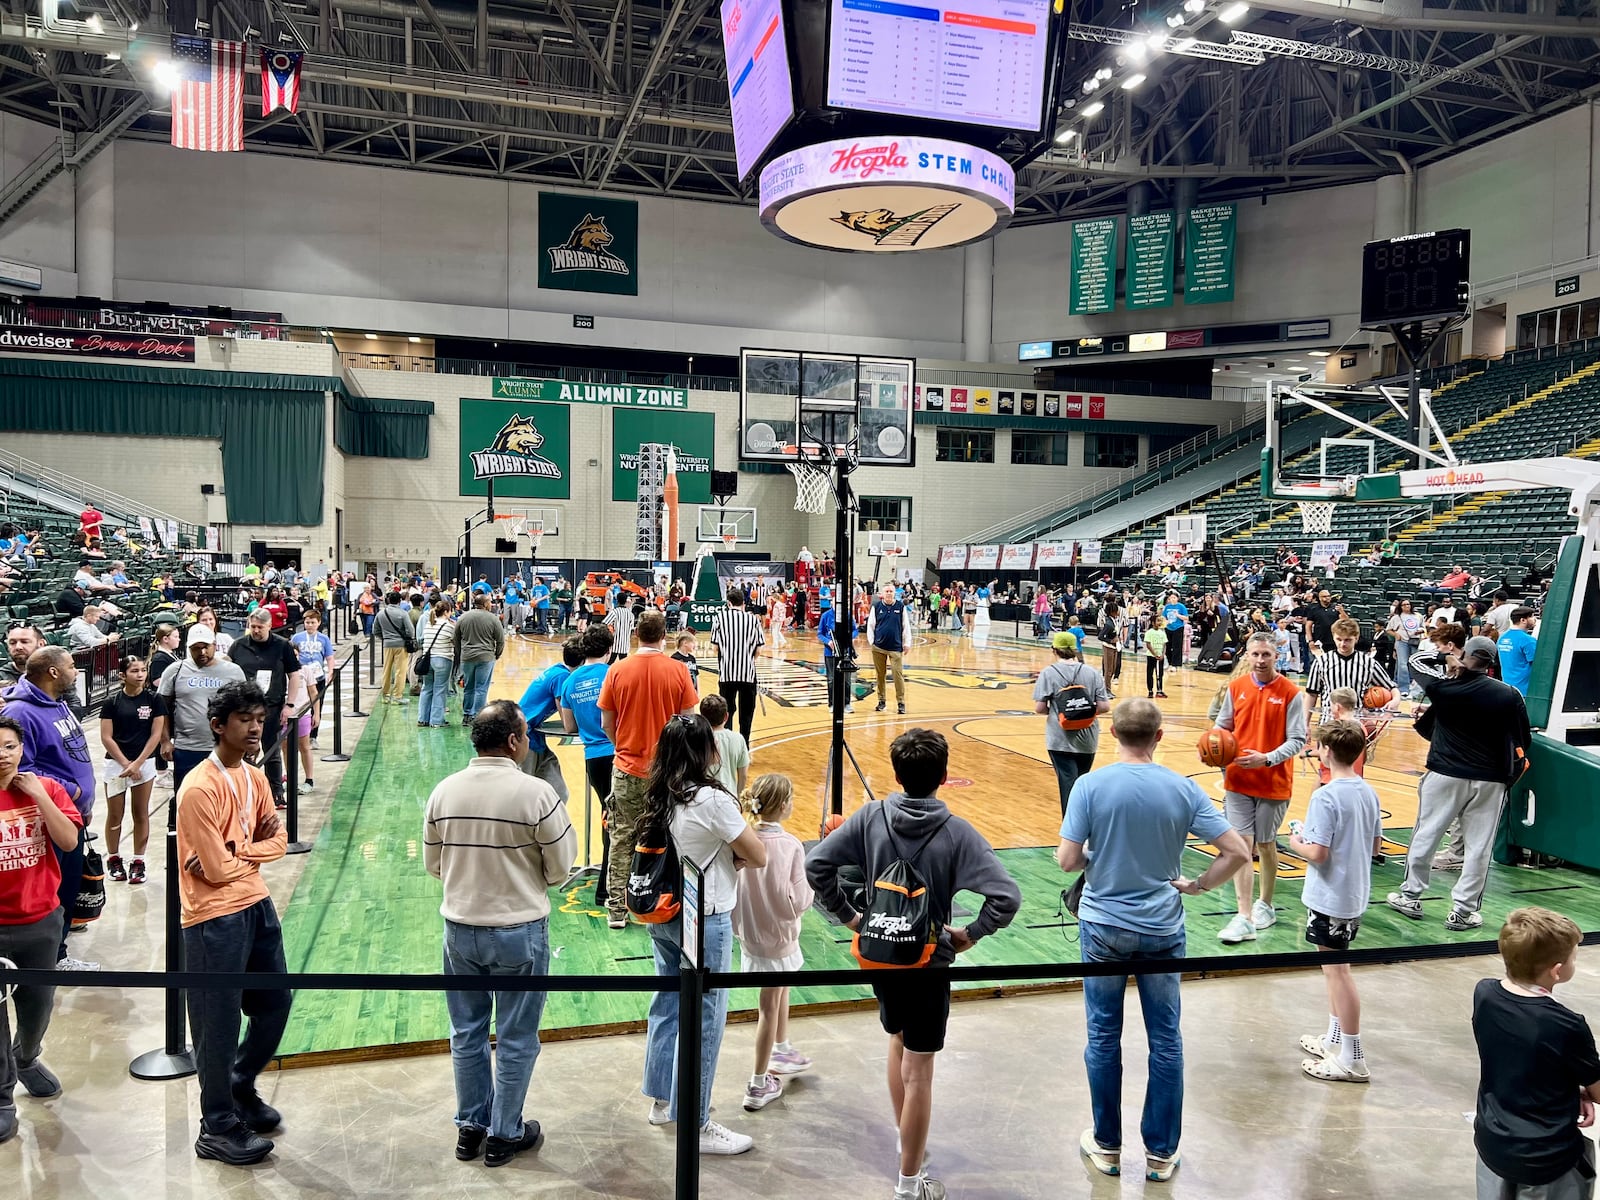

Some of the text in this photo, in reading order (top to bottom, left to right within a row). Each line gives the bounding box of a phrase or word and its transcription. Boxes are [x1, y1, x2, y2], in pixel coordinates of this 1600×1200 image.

[829, 143, 909, 178] Hoopla
[918, 152, 972, 175] STEM
[780, 163, 805, 184] STATE
[1190, 206, 1232, 215] BASKETBALL
[1131, 213, 1171, 222] BASKETBALL
[1075, 220, 1113, 229] BASKETBALL
[1390, 231, 1435, 243] DAKTRONICS
[552, 249, 627, 273] WRIGHT STATE
[1558, 284, 1576, 293] 203
[0, 331, 186, 357] dweiser Brew Deck
[497, 385, 541, 396] ALUMNI
[559, 384, 683, 407] ALUMNI ZONE
[620, 453, 640, 461] WRIG
[675, 456, 709, 464] NIVERSITY
[475, 453, 560, 478] WRIGHT STATE
[674, 463, 709, 472] ENTER
[1426, 472, 1484, 486] HOT HEAD
[690, 604, 727, 613] Select
[570, 689, 593, 699] WRIGHT
[0, 841, 46, 860] RANGER
[868, 912, 913, 935] Hoopla
[881, 934, 916, 942] CHALLENGE
